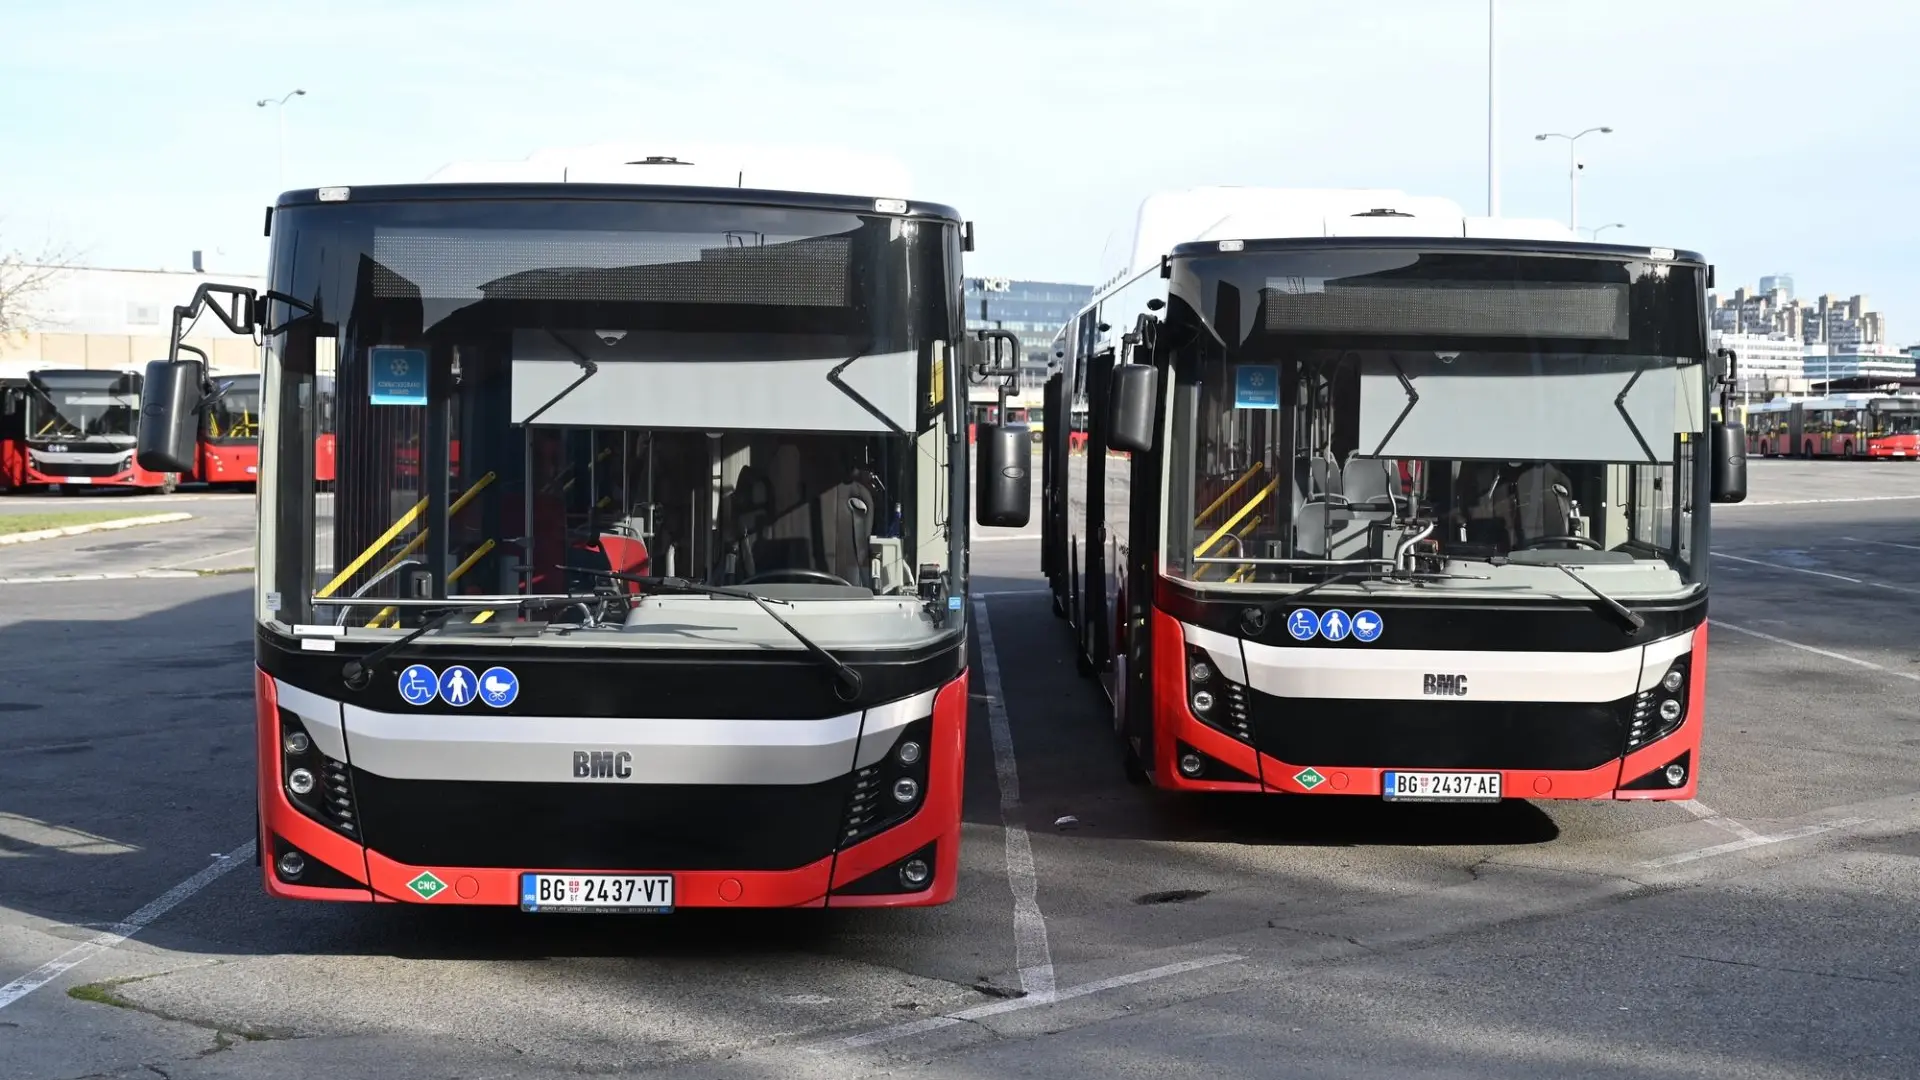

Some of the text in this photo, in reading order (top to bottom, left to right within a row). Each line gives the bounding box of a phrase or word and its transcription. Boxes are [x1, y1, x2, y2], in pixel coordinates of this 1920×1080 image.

[984, 279, 1010, 292] NCR
[1423, 673, 1468, 696] BMC
[573, 751, 632, 779] BMC
[1397, 775, 1418, 793] BG
[417, 880, 437, 890] CNG
[540, 878, 565, 901] BG
